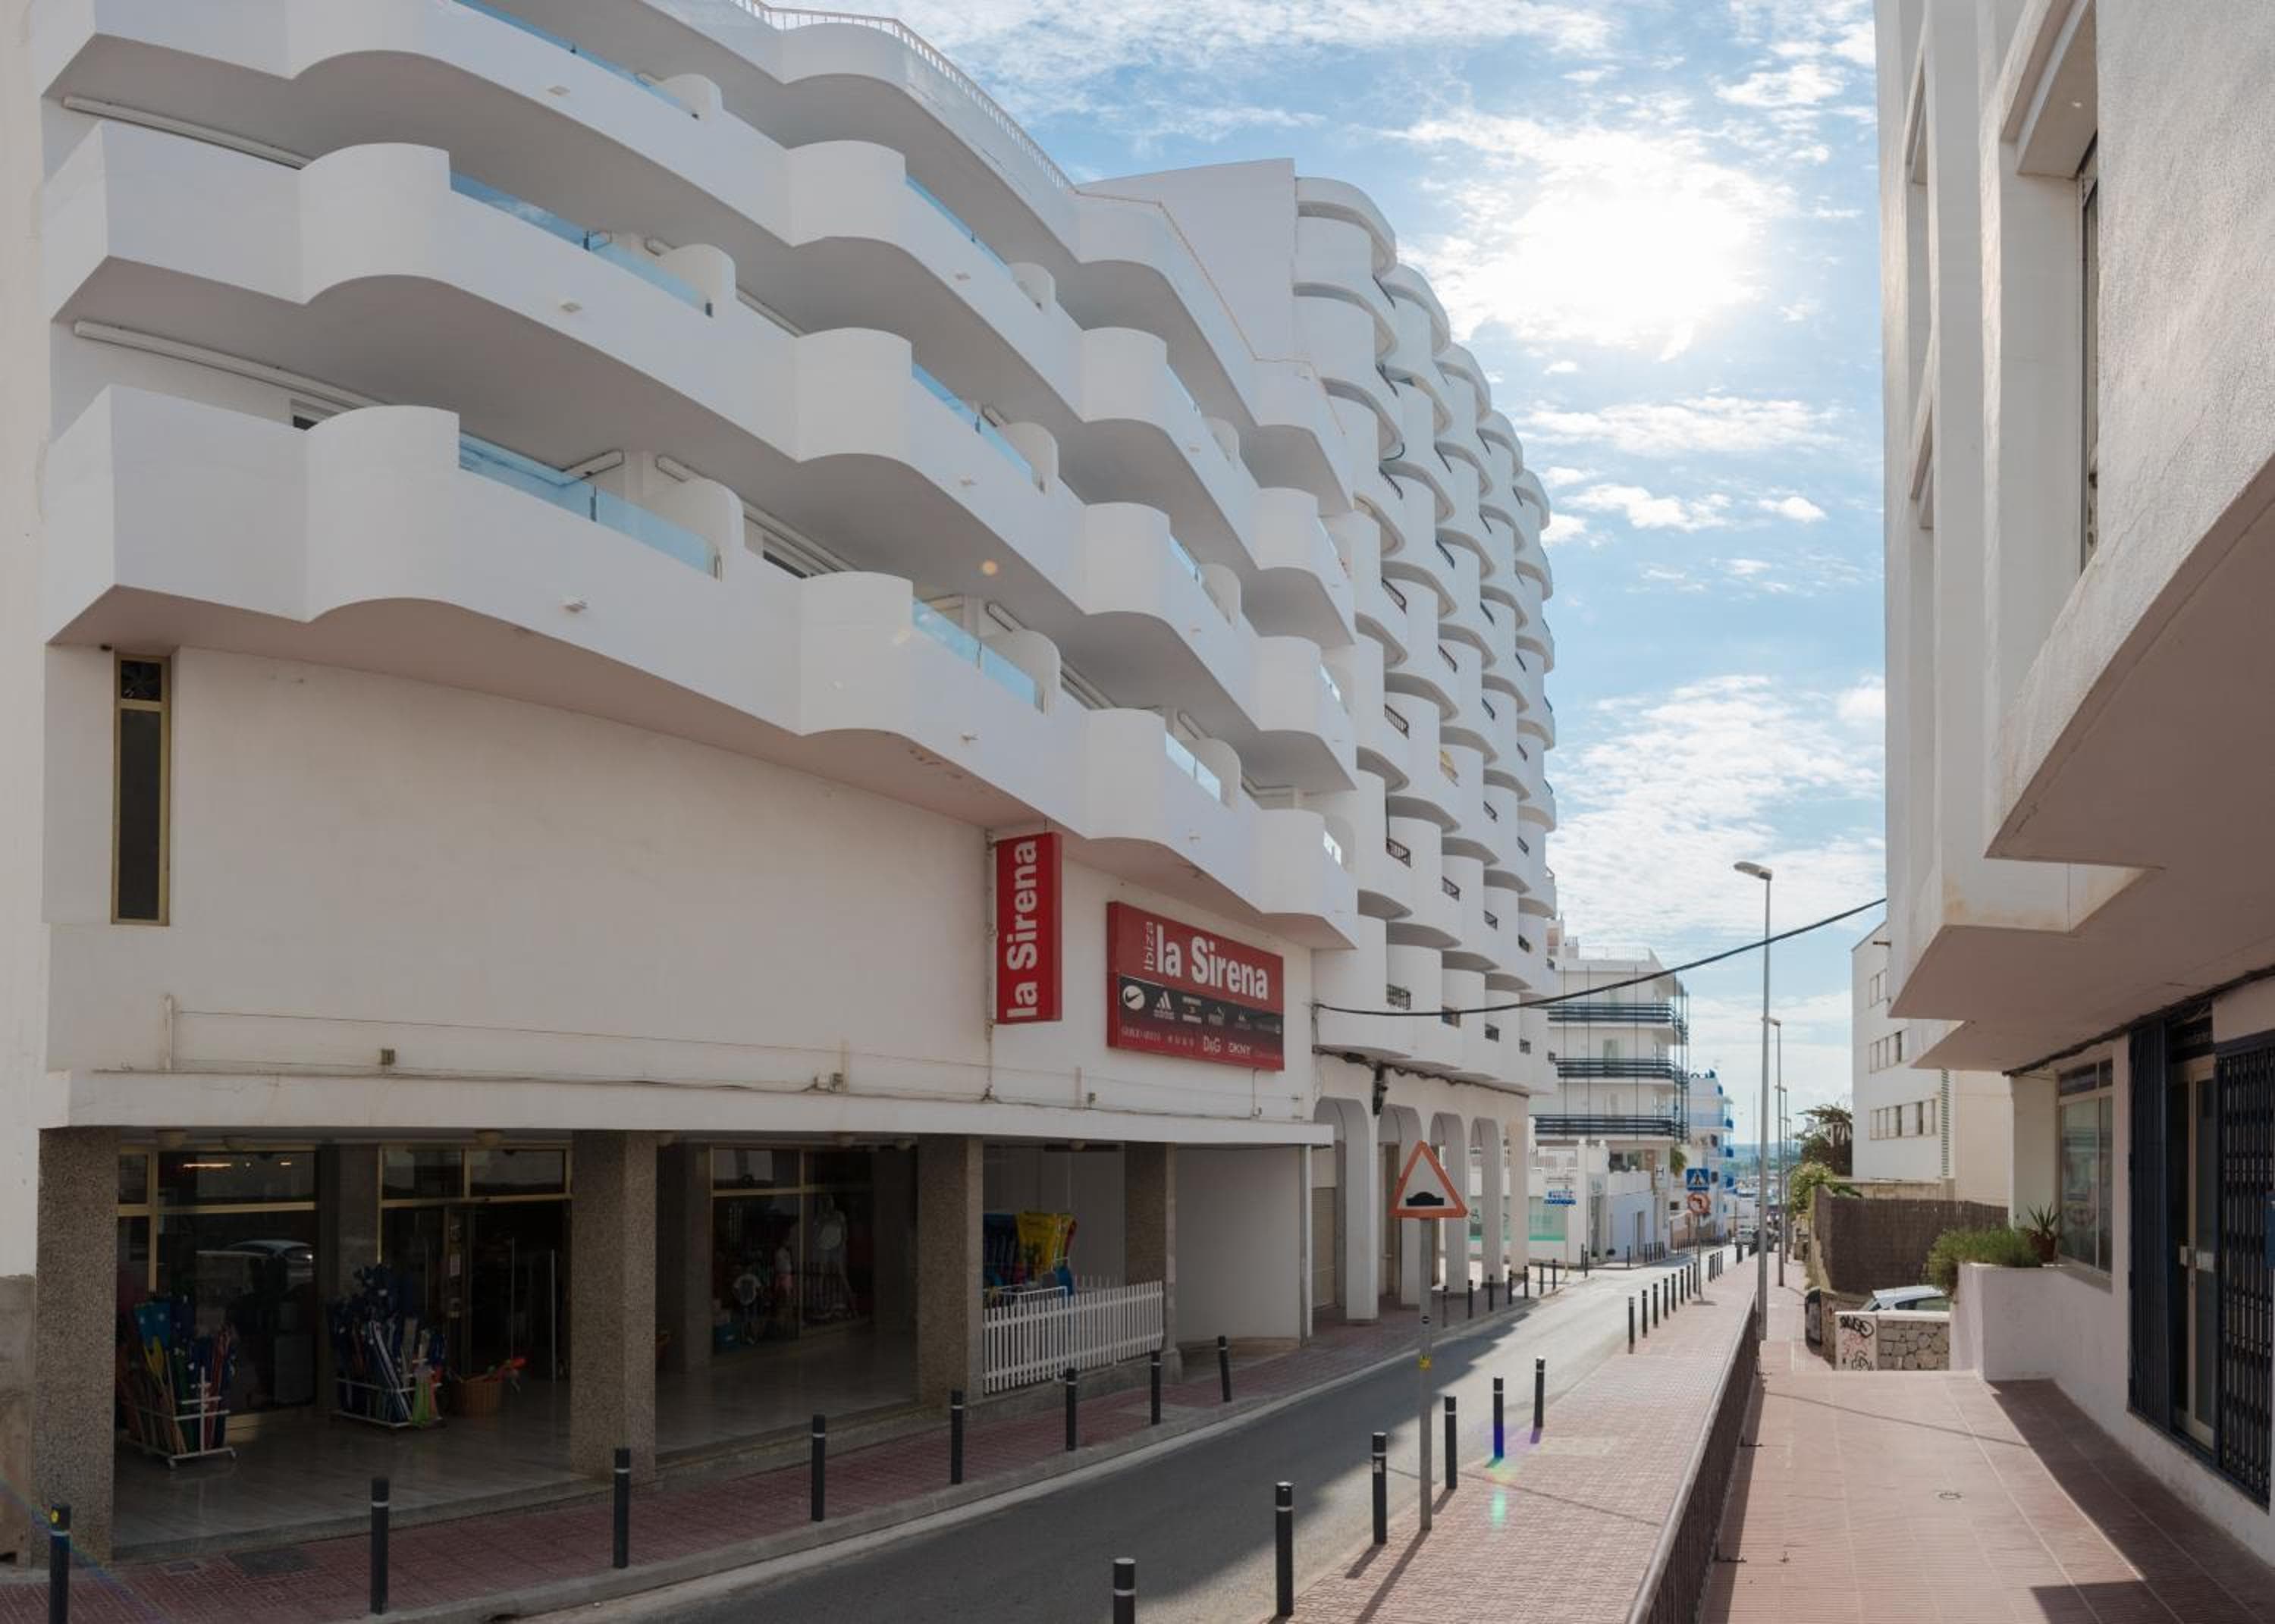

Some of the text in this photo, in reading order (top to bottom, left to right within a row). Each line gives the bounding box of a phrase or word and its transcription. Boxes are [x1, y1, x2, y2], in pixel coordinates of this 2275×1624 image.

[1006, 840, 1037, 1018] la Sirena
[1156, 924, 1269, 1001] la Sirena
